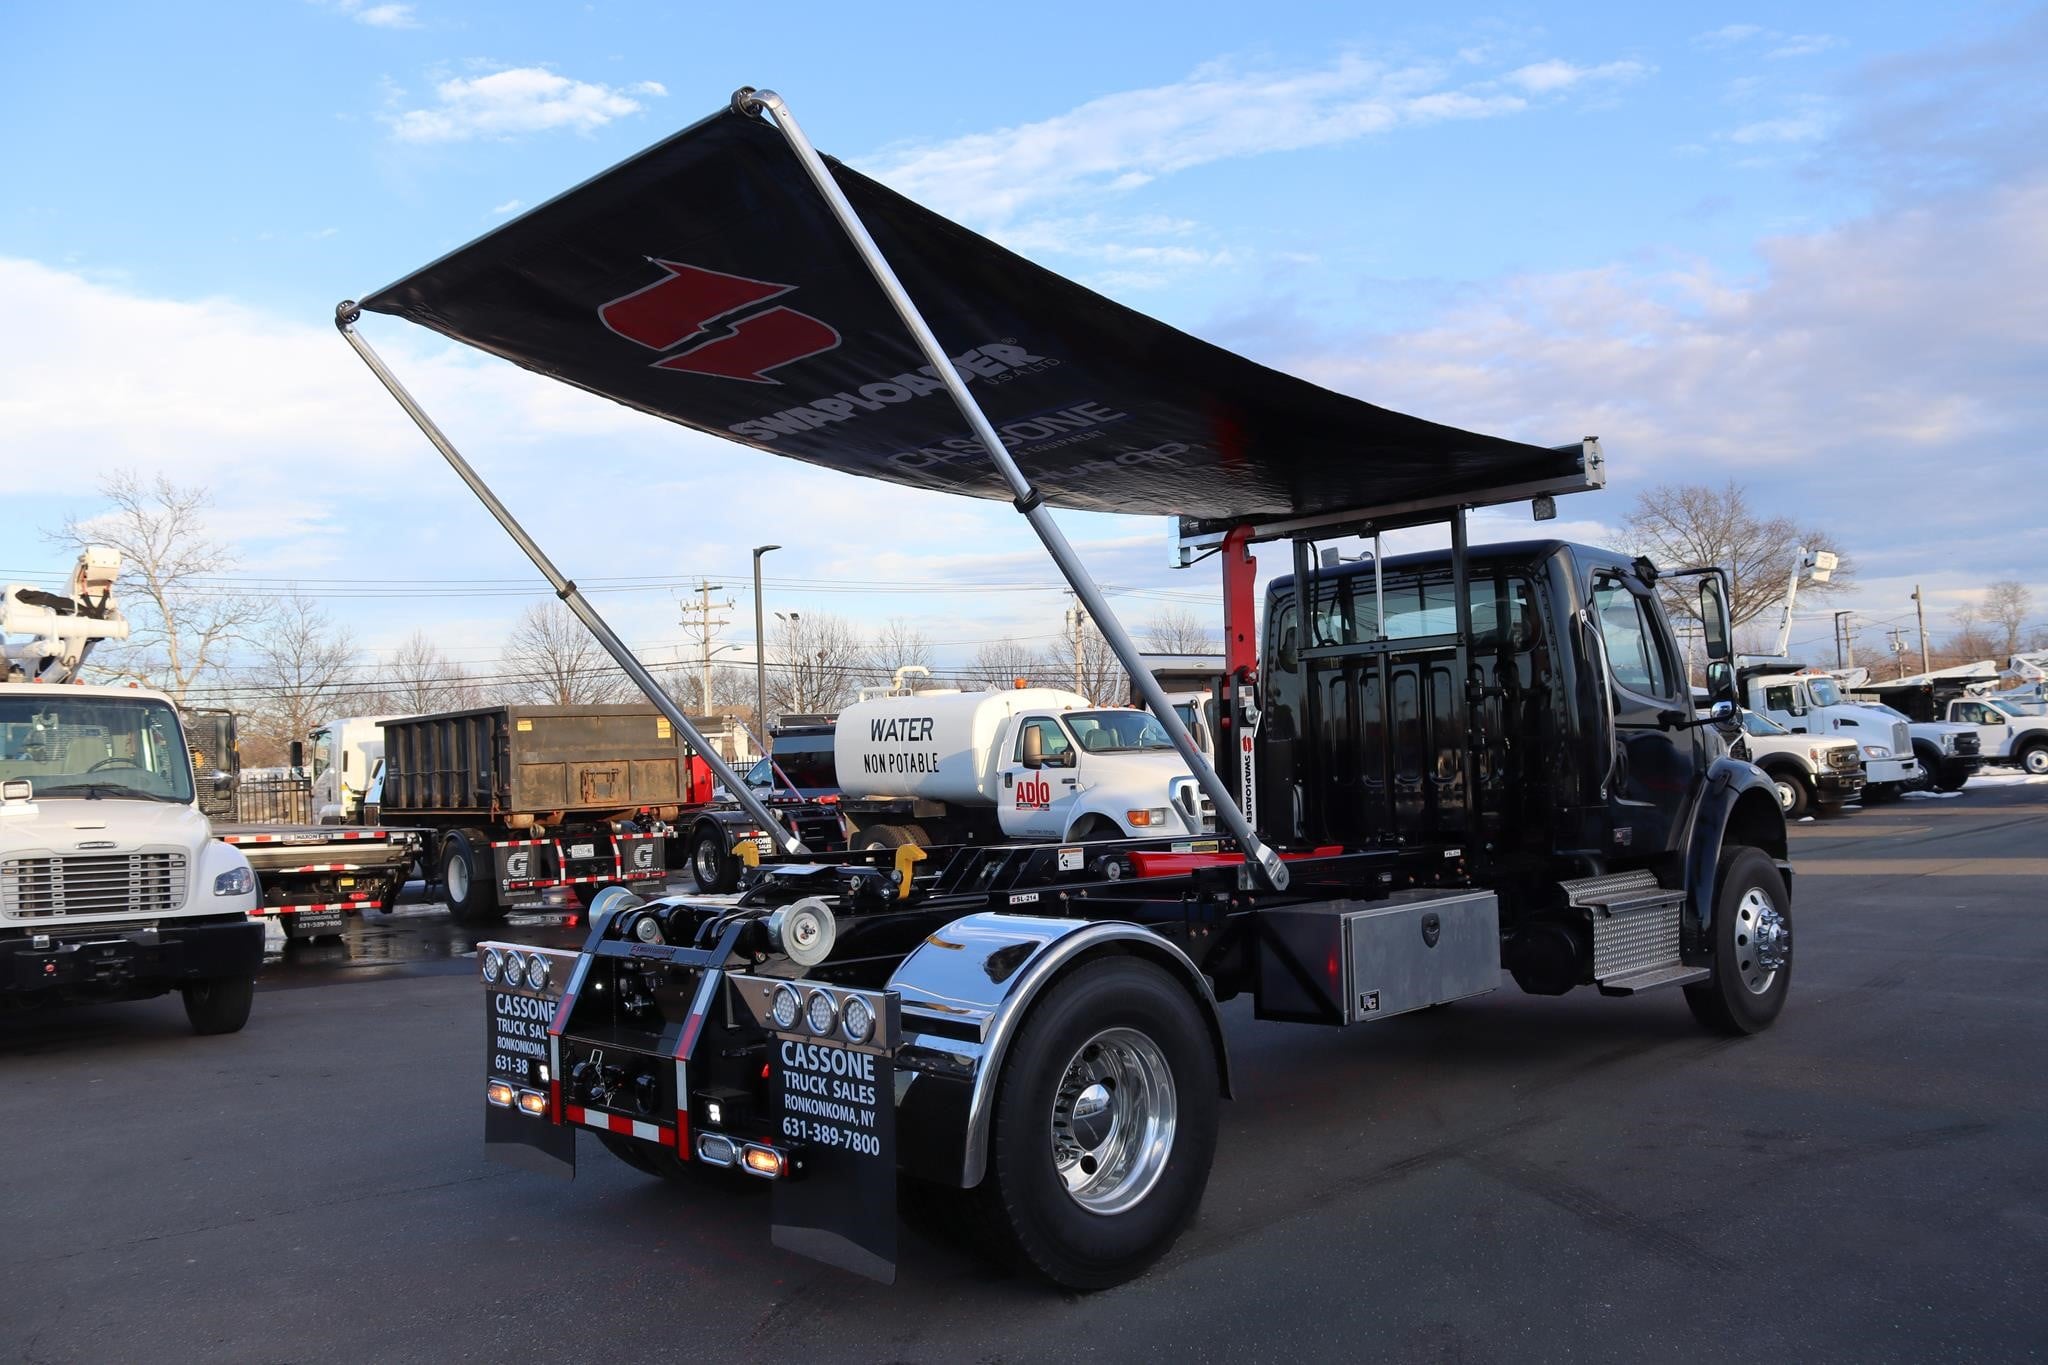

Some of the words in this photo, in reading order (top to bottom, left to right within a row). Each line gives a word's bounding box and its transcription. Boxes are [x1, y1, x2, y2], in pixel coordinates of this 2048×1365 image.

[728, 343, 1046, 441] SWAPLOADER
[871, 717, 934, 741] WATER
[864, 753, 887, 773] NON
[889, 752, 940, 773] POTABLE
[1244, 754, 1253, 824] SWAPLOADER
[496, 1017, 527, 1036] TRUCK
[781, 1040, 876, 1082] CASSONE
[783, 1070, 828, 1096] TRUCK
[833, 1080, 876, 1105] SALES
[784, 1093, 859, 1127] RONKONKOMA,
[860, 1109, 876, 1128] NY
[782, 1117, 880, 1157] 631-389-7800
